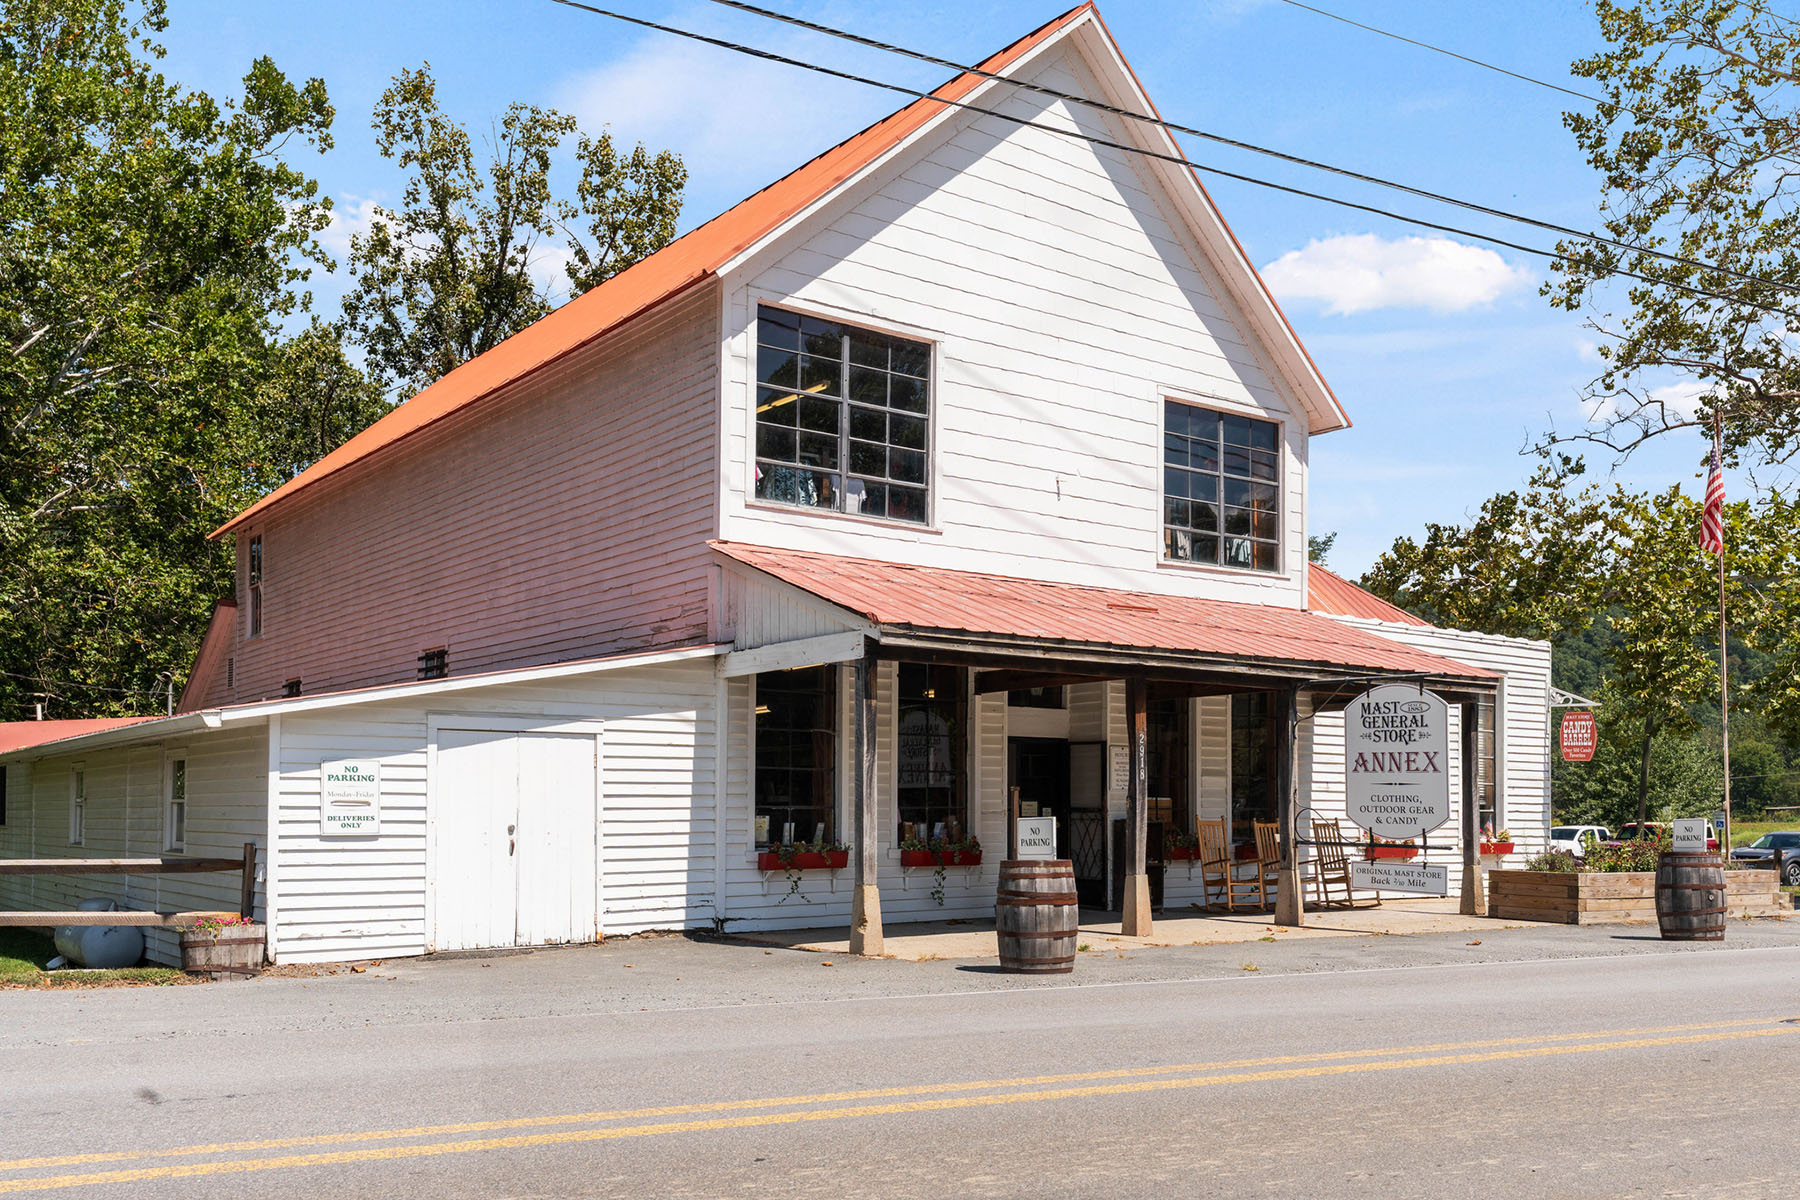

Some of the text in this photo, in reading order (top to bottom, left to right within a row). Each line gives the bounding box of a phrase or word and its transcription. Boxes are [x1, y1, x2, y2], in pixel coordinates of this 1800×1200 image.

[1361, 701, 1400, 719] MAST
[1362, 714, 1428, 729] GENERAL
[1563, 720, 1593, 734] CANDY
[1373, 729, 1416, 746] STORE
[1563, 733, 1593, 746] BARREL
[1352, 751, 1440, 773] ANNEX
[344, 765, 359, 773] NO
[327, 774, 375, 782] PARKING
[1370, 794, 1422, 804] CLOTHING,
[1359, 805, 1435, 815] OUTDOOR GEAR
[1375, 816, 1418, 825] & CANDY
[1030, 827, 1041, 835] NO
[1684, 825, 1693, 833] NO
[1020, 838, 1050, 847] PARKING
[1676, 834, 1702, 842] PARKING
[1356, 867, 1442, 879] ORIGINAL MAST STORE
[1370, 876, 1391, 885] Back
[1407, 879, 1426, 888] Mile
